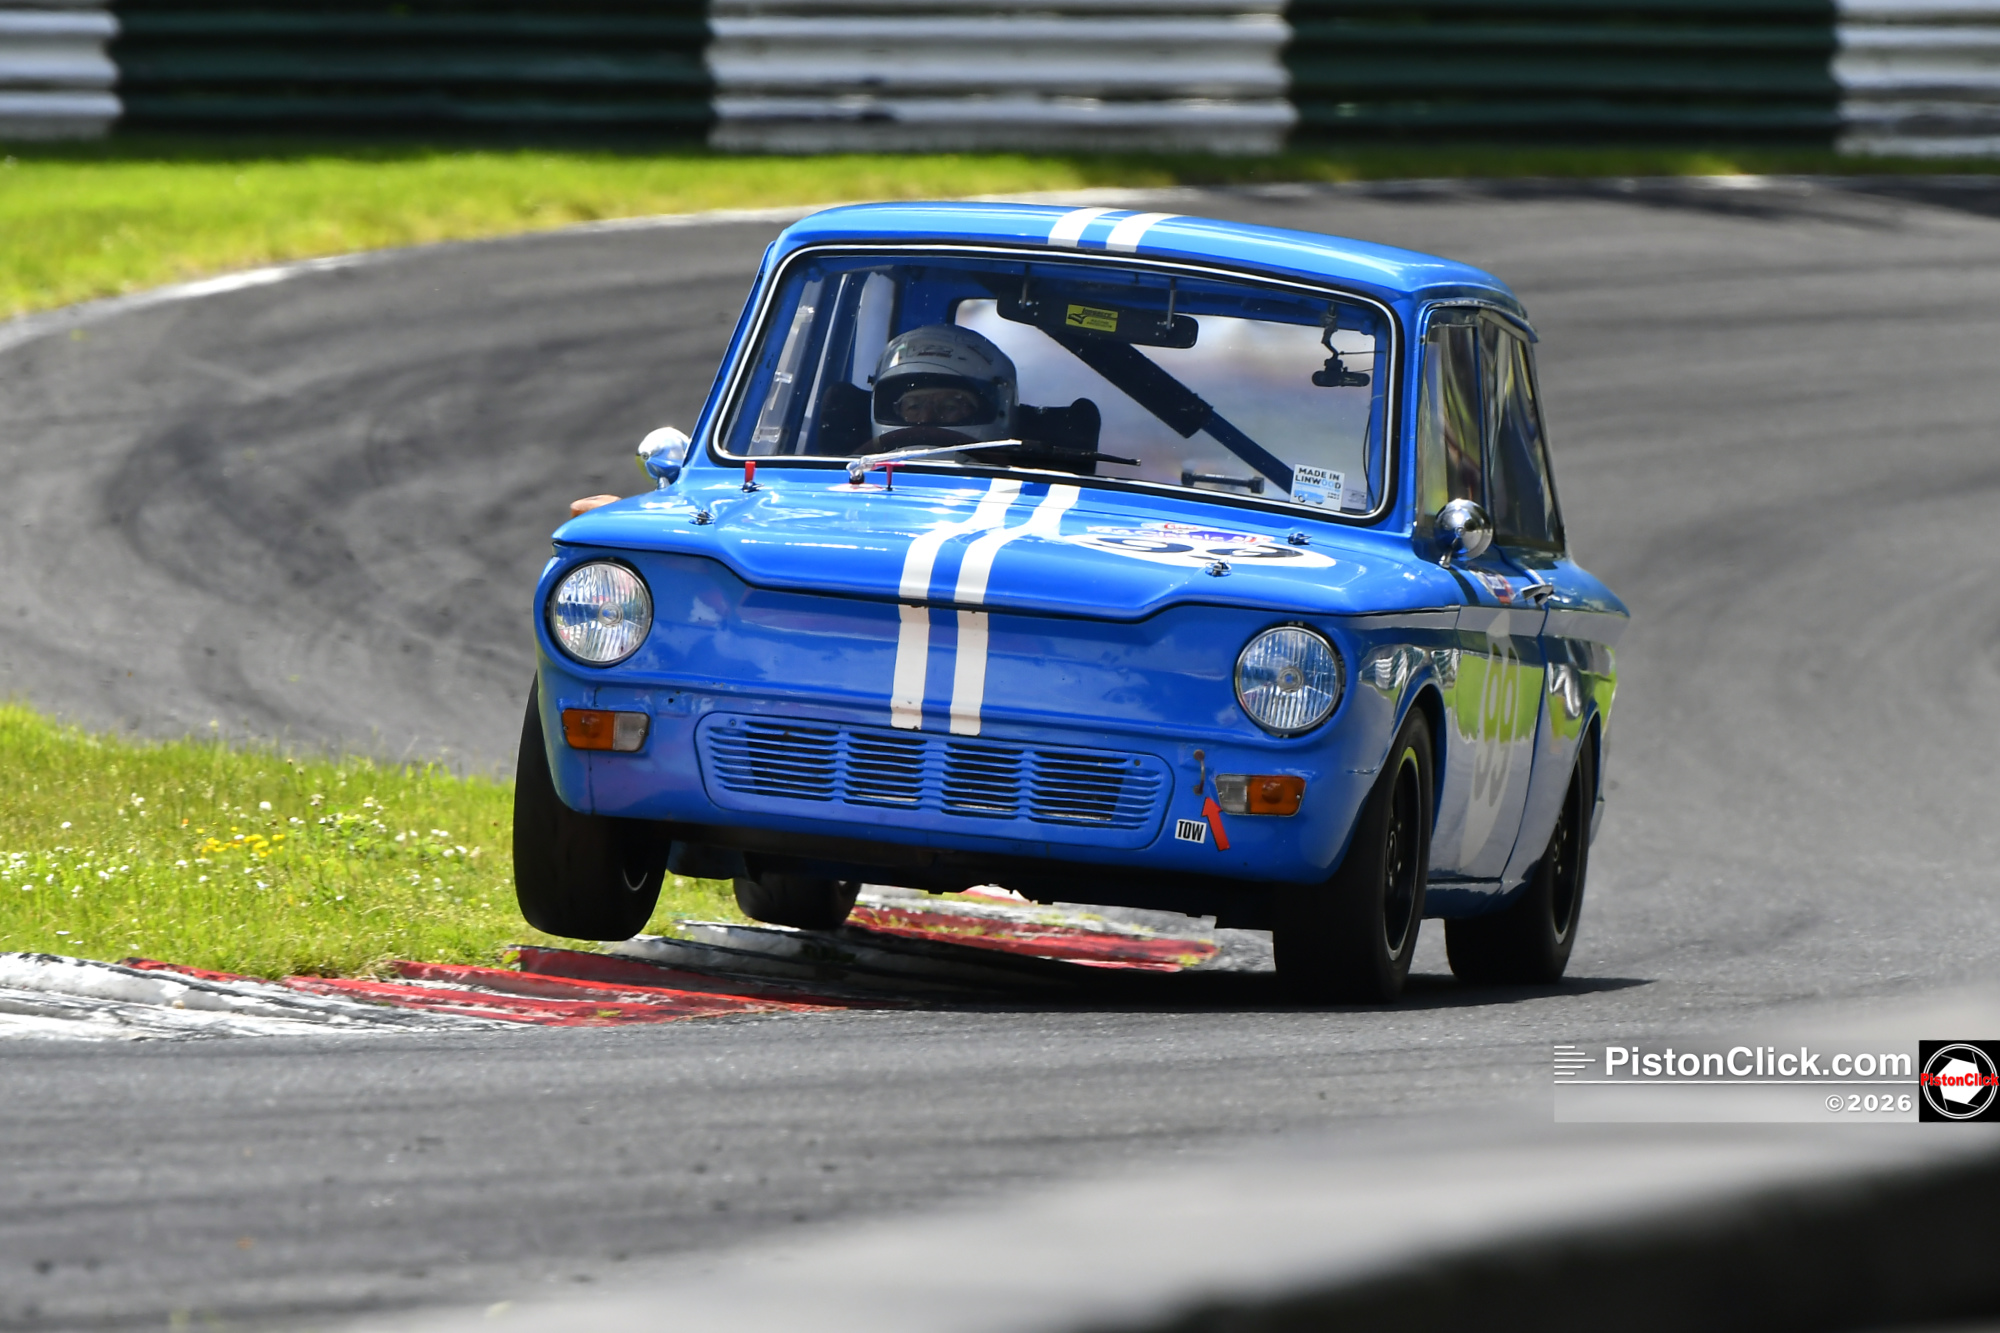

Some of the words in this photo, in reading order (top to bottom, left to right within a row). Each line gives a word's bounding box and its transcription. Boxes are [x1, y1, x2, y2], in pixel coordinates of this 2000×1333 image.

[1295, 474, 1341, 490] LINWOOD
[1298, 467, 1327, 479] MADE
[1329, 472, 1340, 481] IN
[1177, 820, 1205, 842] TOW
